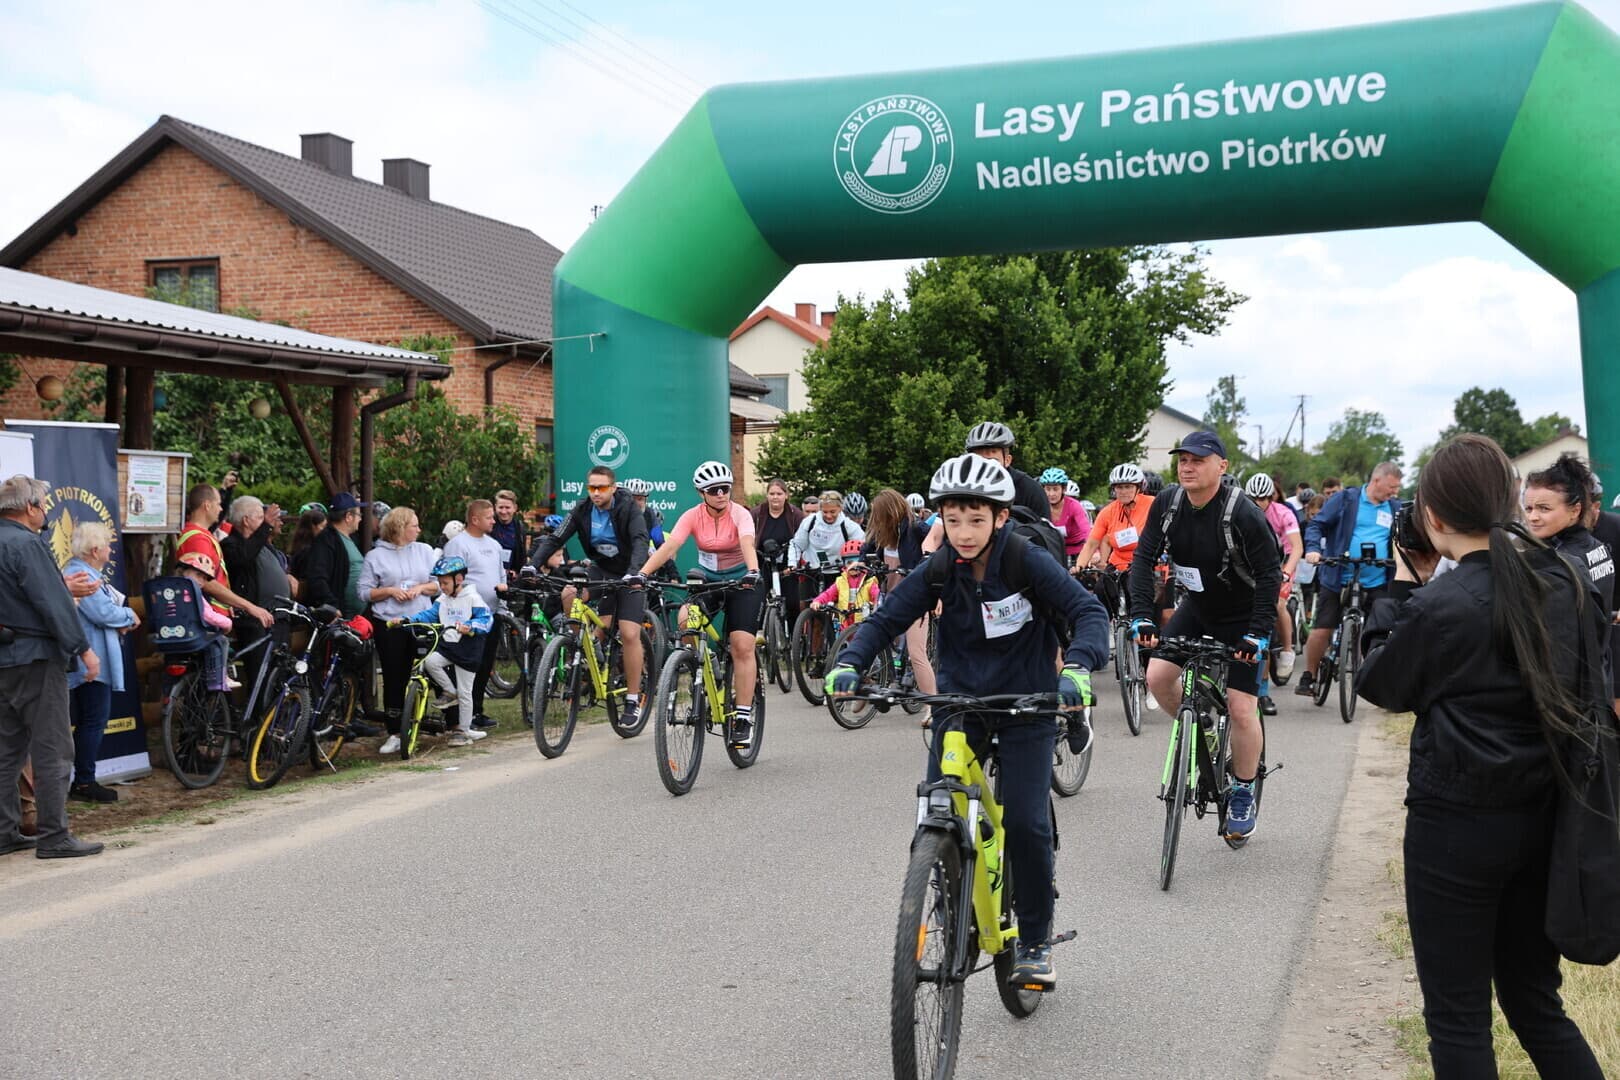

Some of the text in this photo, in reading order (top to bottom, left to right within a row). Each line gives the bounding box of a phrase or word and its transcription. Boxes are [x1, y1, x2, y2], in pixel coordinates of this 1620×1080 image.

[839, 97, 948, 152] LASY PAŃSTWOWE
[975, 72, 1387, 142] Lasy Państwowe
[976, 129, 1387, 190] Nadleśnictwo Piotrków
[561, 479, 583, 495] Lasy
